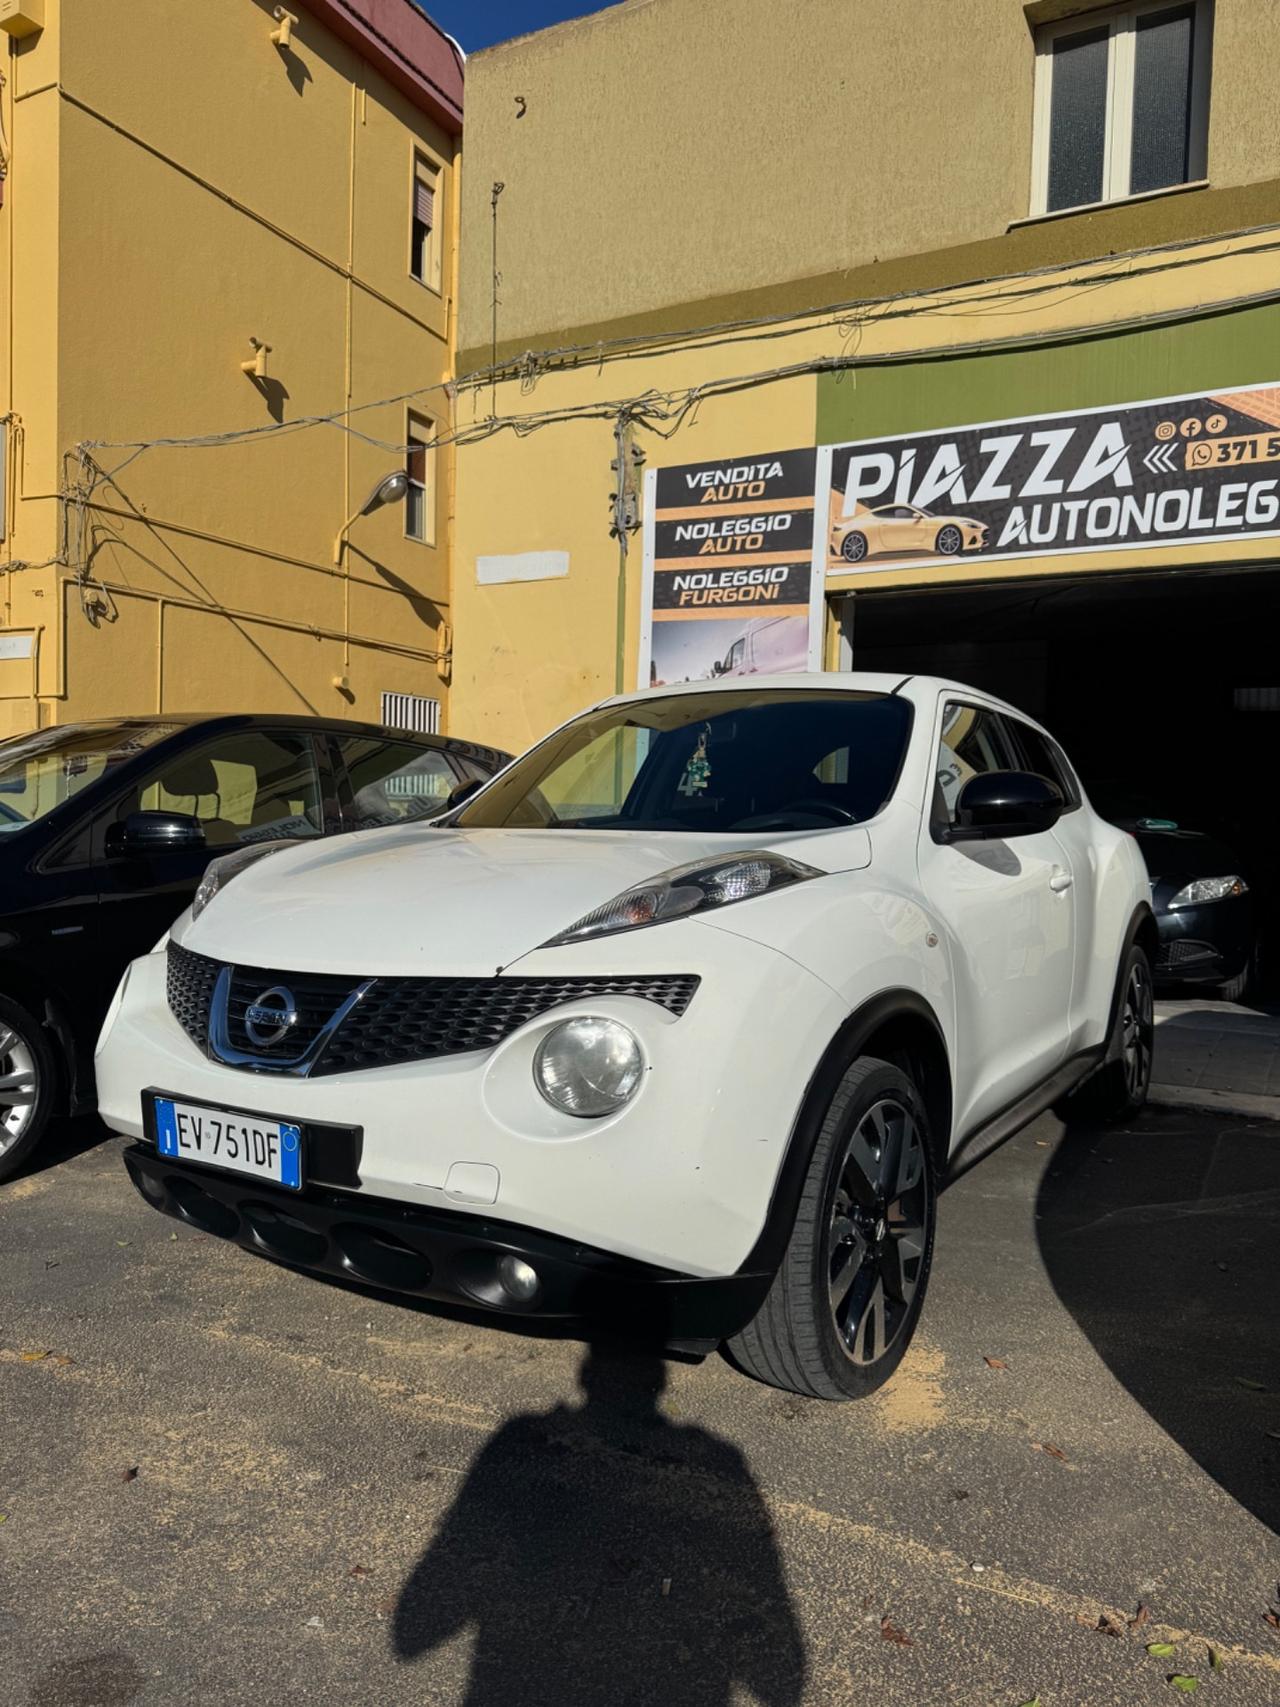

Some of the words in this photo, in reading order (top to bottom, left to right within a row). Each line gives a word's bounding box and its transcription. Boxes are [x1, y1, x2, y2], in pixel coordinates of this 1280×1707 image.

[1217, 440, 1258, 463] 371
[686, 461, 784, 489] VENDITA
[842, 422, 1134, 517] PIAZZA
[701, 480, 766, 503] AUTO
[996, 479, 1279, 547] AUTONOLEG
[675, 514, 792, 542] NOLEGGIO
[698, 534, 764, 554] AUTO
[673, 567, 789, 591] NOLEGGIO
[679, 584, 780, 606] FURGONI
